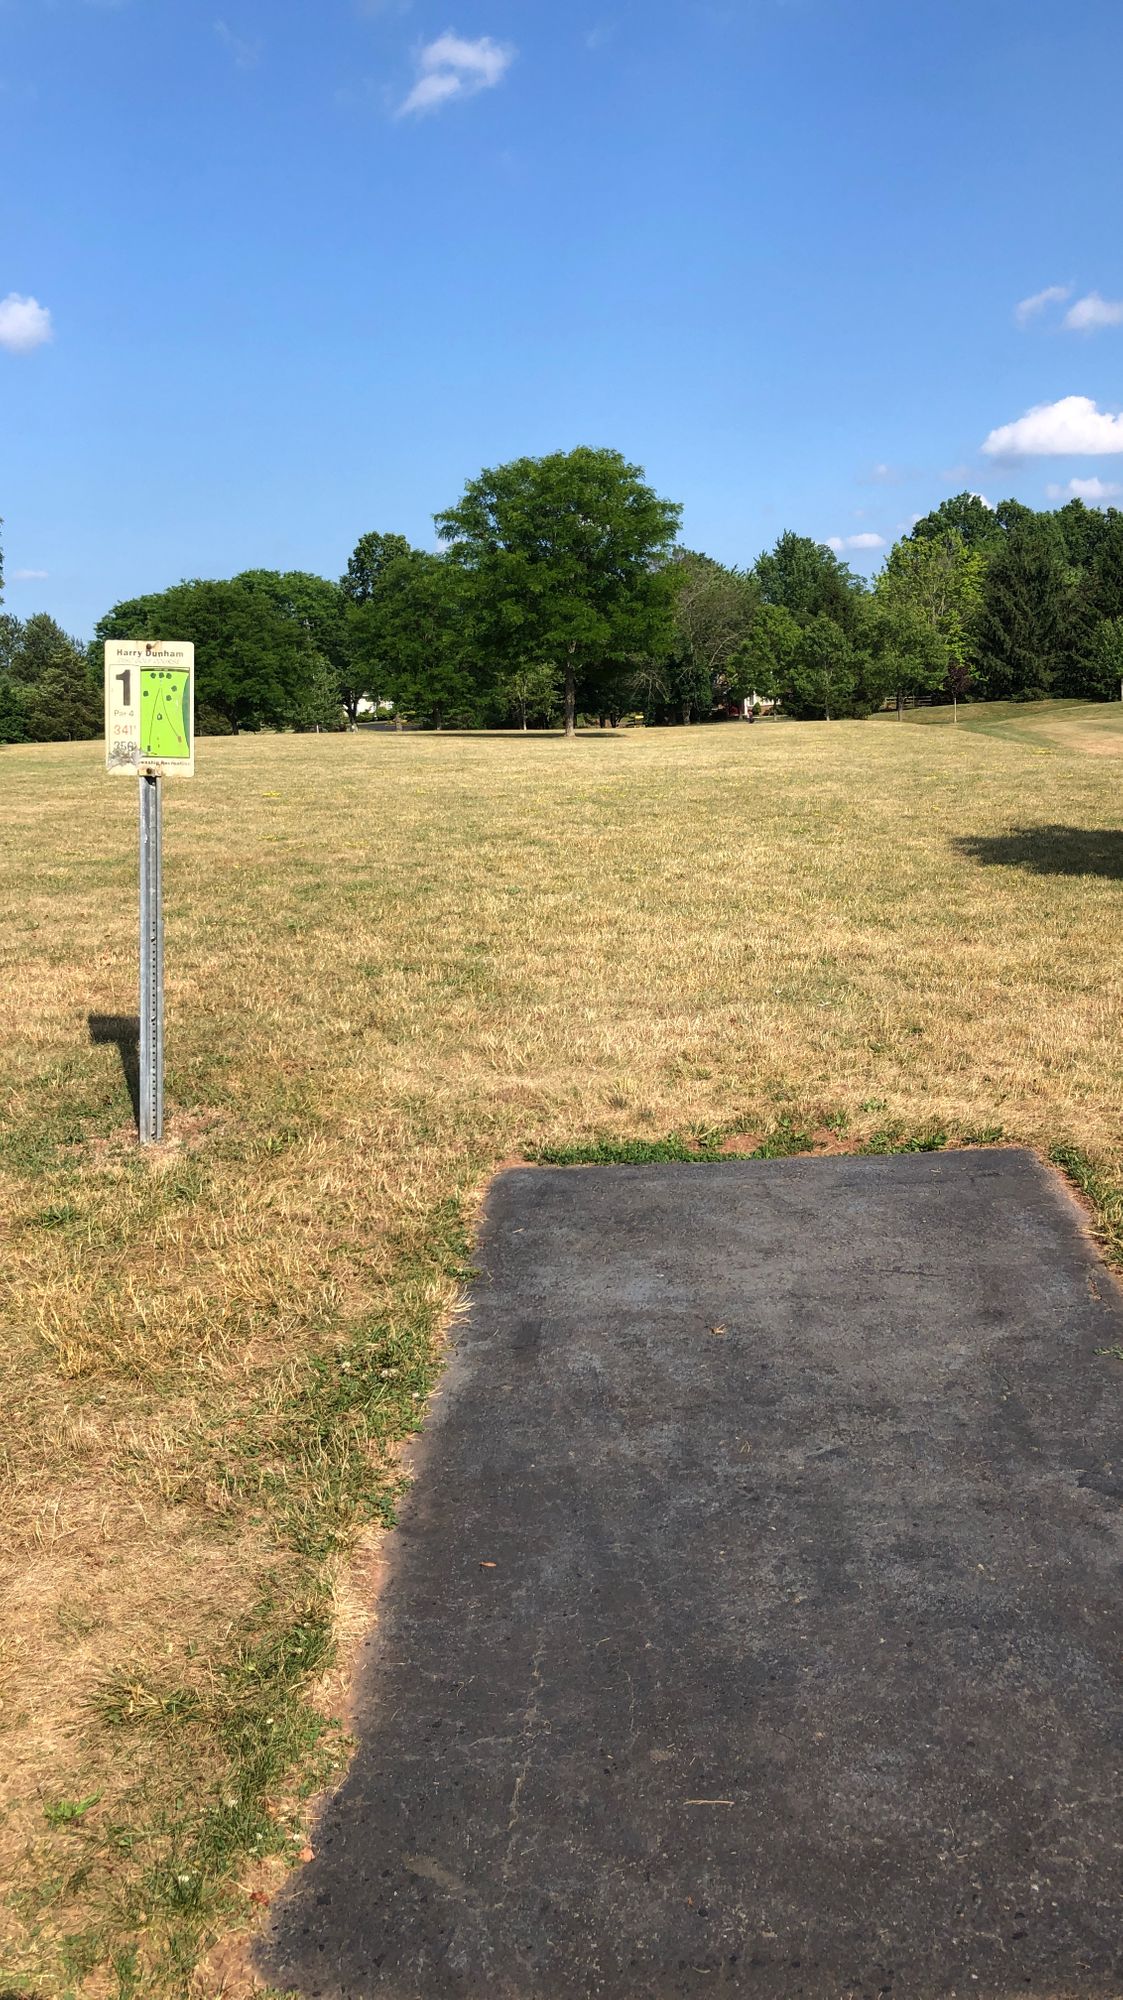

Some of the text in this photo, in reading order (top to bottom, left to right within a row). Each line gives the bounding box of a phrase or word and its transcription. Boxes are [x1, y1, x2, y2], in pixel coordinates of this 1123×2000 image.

[116, 648, 184, 658] Harry Dunham
[115, 669, 131, 706] 1
